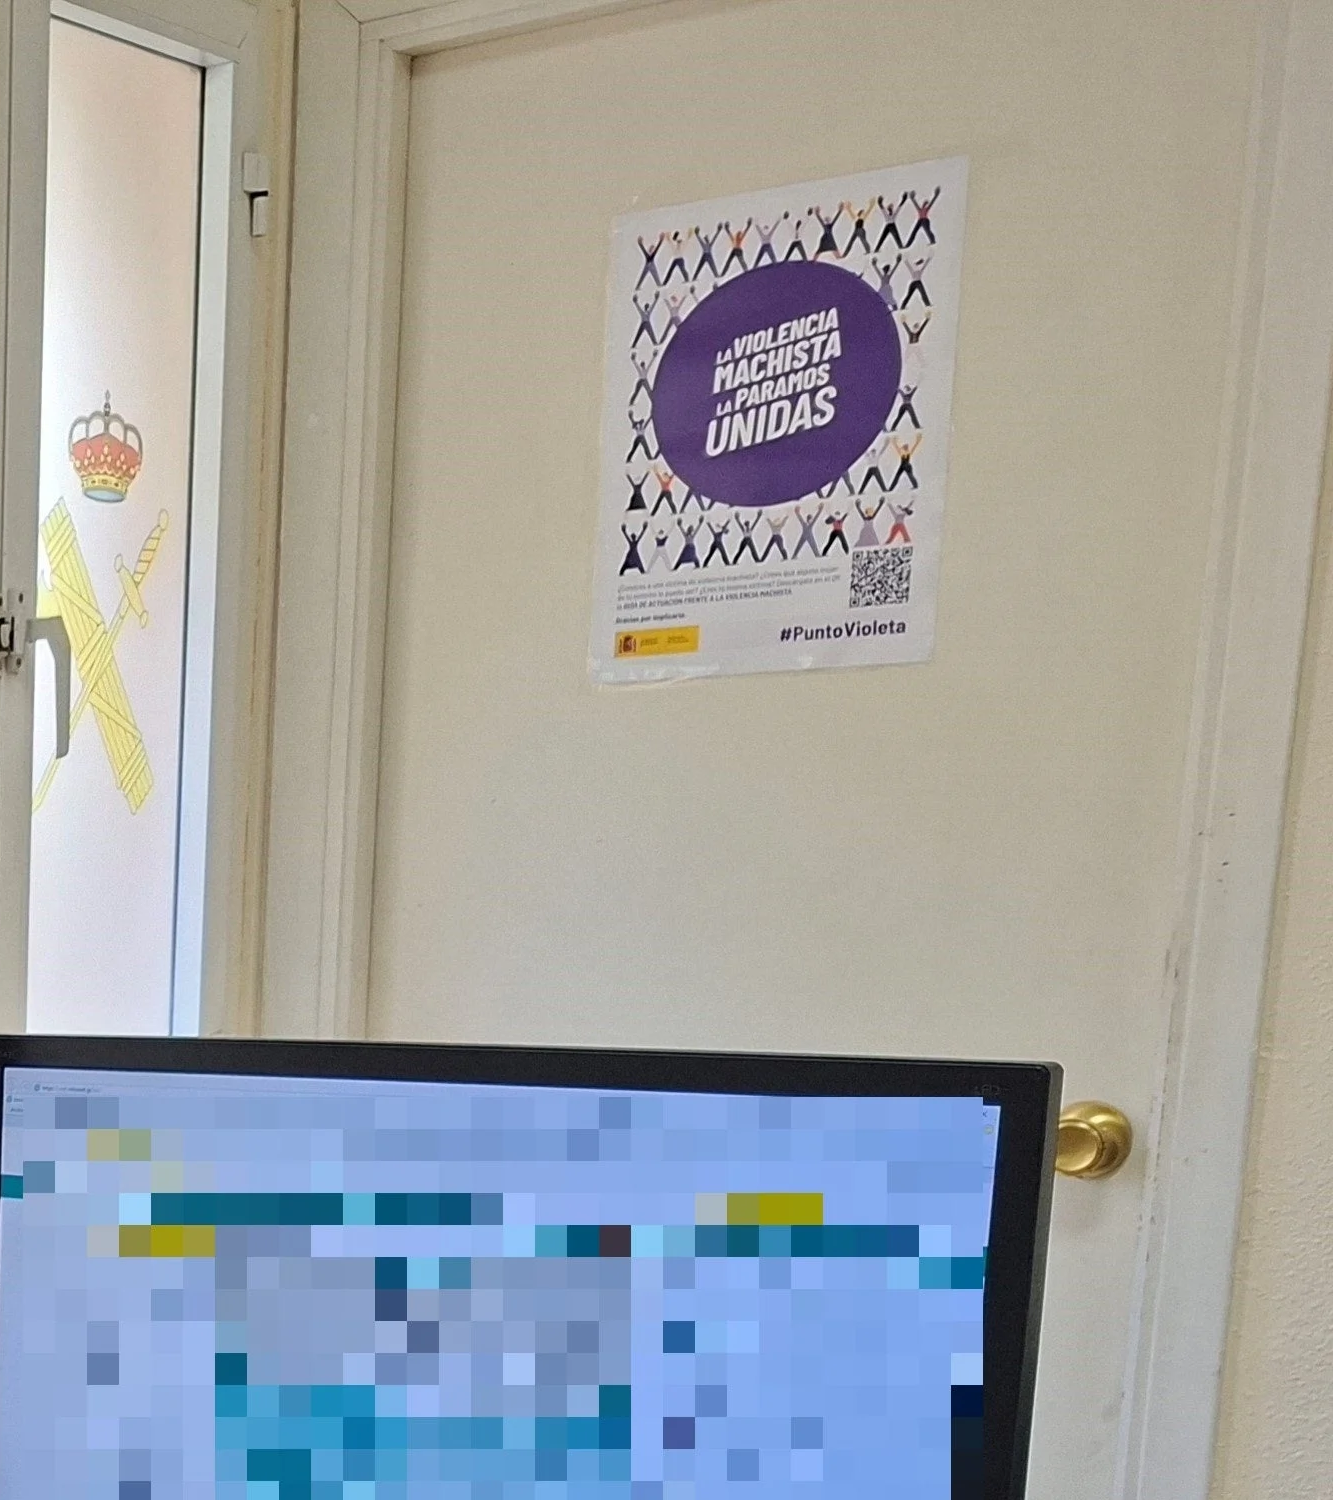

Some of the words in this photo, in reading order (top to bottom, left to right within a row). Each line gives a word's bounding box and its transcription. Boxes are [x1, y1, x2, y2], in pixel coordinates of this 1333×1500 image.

[713, 330, 842, 394] MACHISTA
[715, 347, 732, 365] LA
[734, 307, 839, 359] VIOLENCIA
[715, 400, 732, 416] LA
[735, 363, 830, 411] PARAMOS
[706, 385, 837, 457] UNIDAS
[780, 619, 906, 641] #PuntoVioleta
